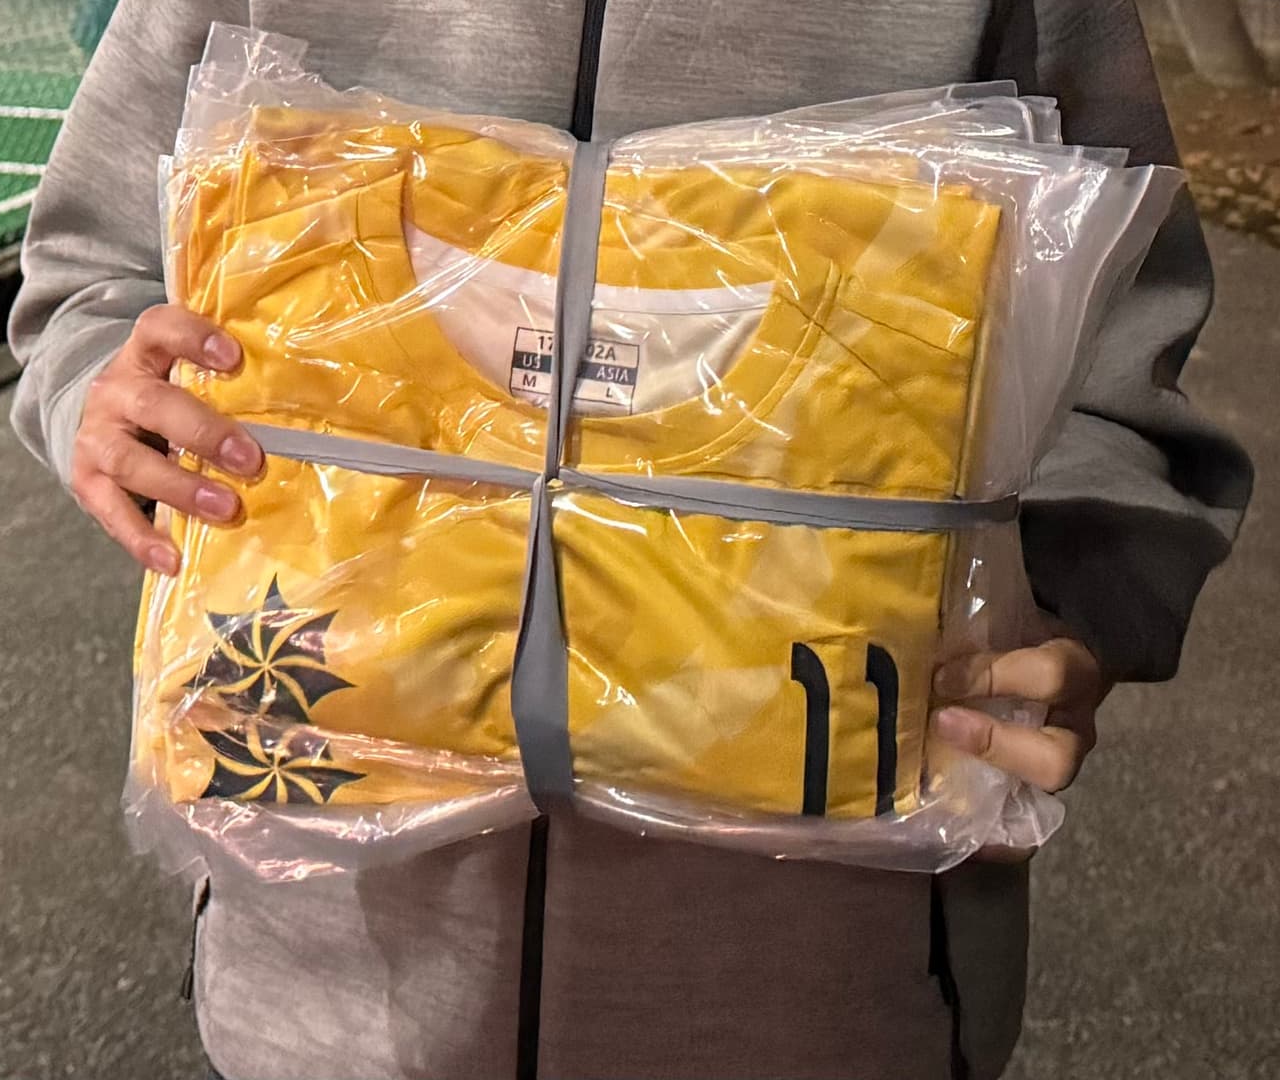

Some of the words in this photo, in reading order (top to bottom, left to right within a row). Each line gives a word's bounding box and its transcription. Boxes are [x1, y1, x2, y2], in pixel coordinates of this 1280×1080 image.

[522, 354, 541, 369] US
[596, 366, 629, 382] ASIA
[522, 373, 537, 388] M
[605, 386, 614, 398] L
[790, 641, 900, 817] 11
